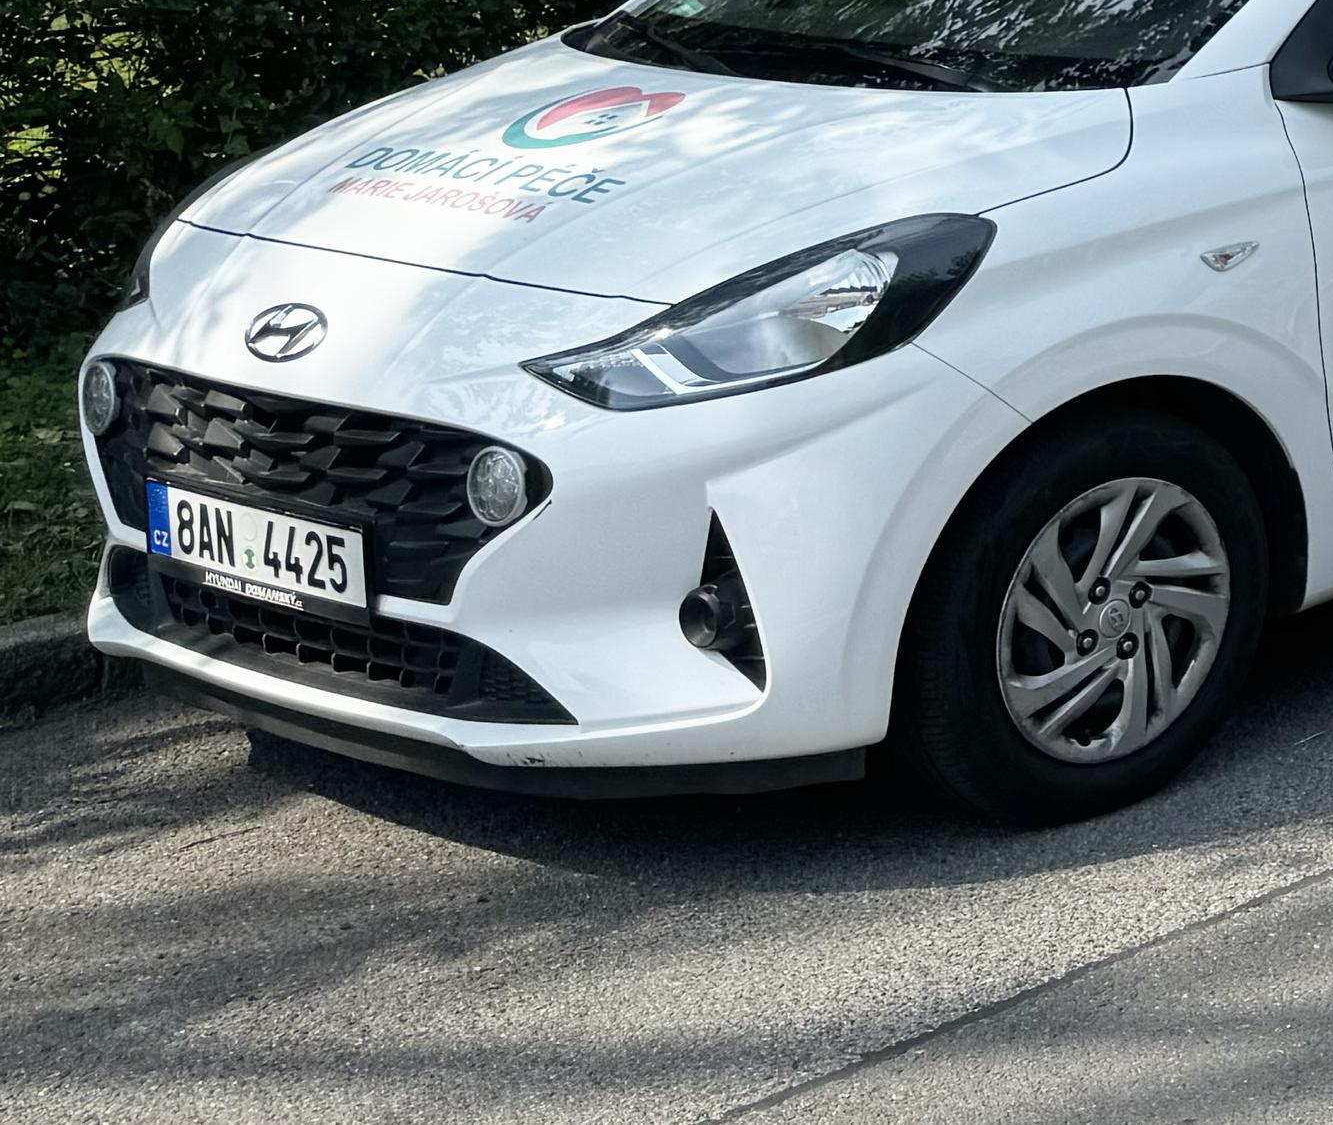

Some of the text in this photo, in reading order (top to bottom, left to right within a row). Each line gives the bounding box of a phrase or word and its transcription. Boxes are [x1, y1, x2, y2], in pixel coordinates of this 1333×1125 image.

[328, 177, 548, 224] MARIE JAROŠOVÁ
[344, 147, 626, 204] DOMÁCÍ PÉČE
[153, 529, 169, 548] CZ
[176, 499, 348, 593] 8AN 4425
